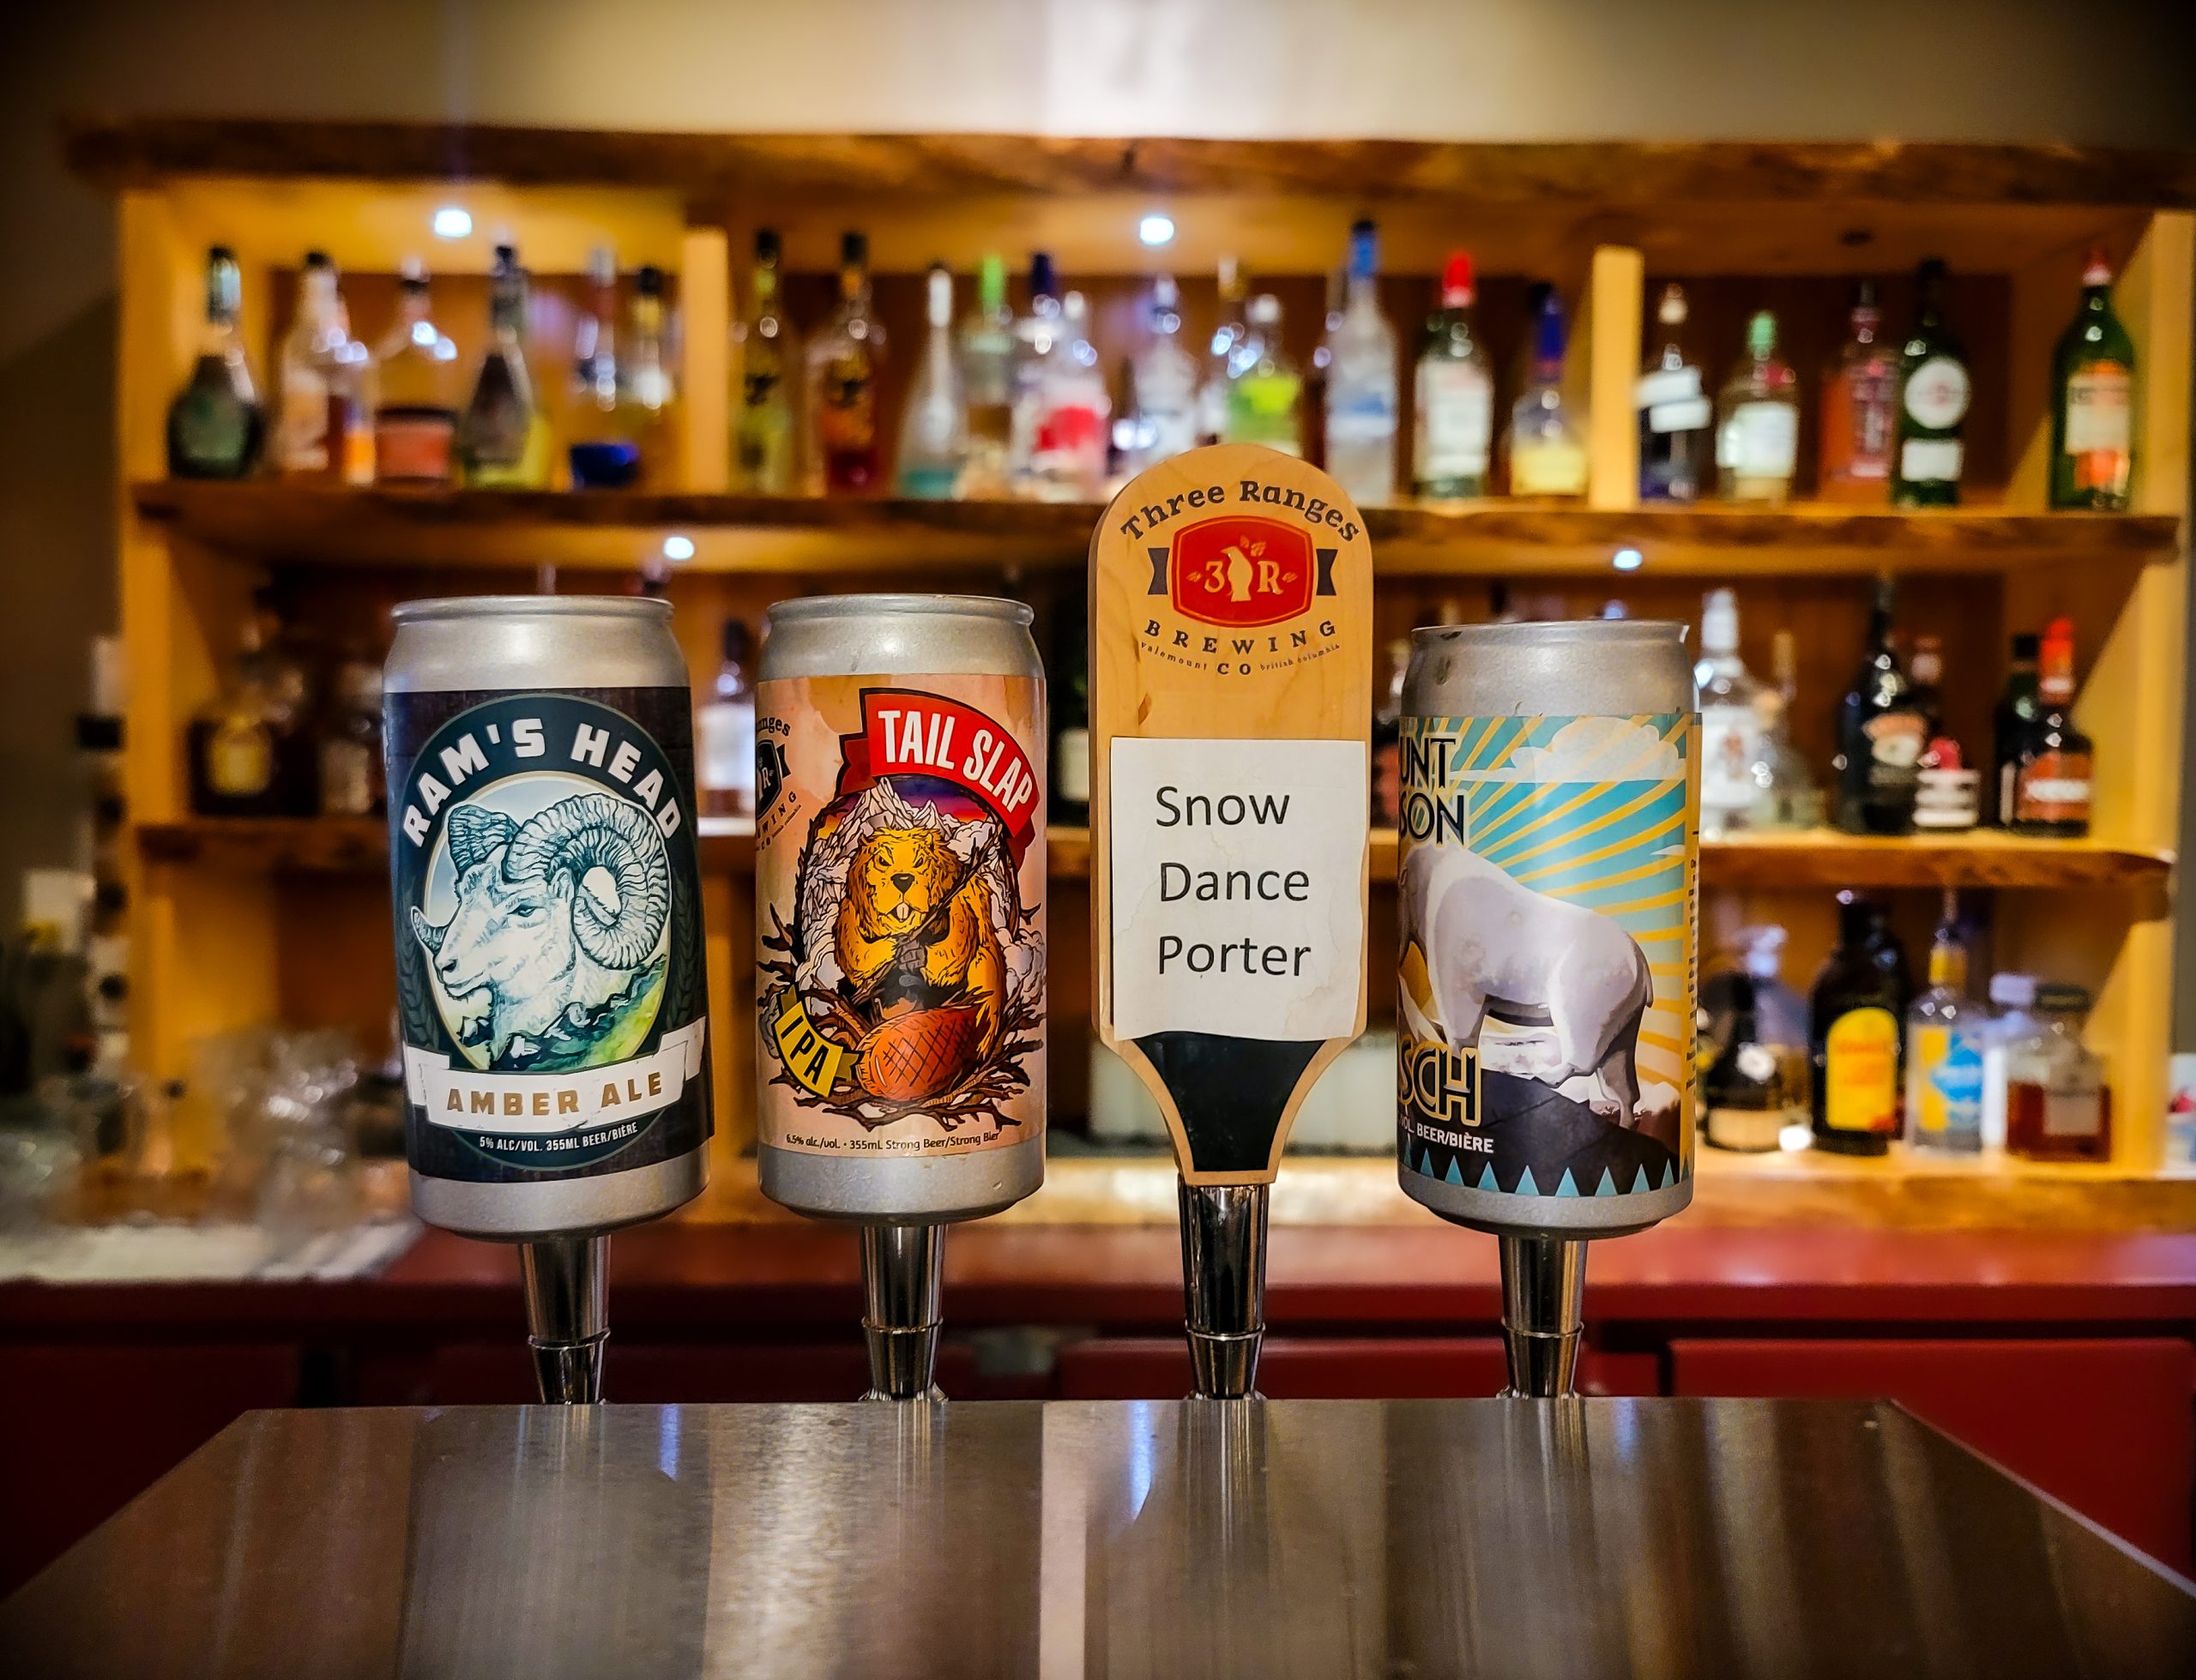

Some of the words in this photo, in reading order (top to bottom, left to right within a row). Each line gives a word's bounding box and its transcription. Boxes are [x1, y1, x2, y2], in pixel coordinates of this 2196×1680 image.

[1120, 485, 1225, 540] Three
[1240, 480, 1360, 542] Ranges
[1204, 560, 1225, 593] 3
[1257, 560, 1283, 594] R
[1144, 620, 1336, 655] BREWING
[1217, 662, 1252, 676] CO
[878, 710, 956, 770] TAIL
[962, 729, 1033, 813] SLAP
[403, 718, 546, 847] RAM'S
[570, 723, 682, 840] HEAD
[1155, 786, 1290, 827] Snow
[1161, 862, 1310, 901] Dance
[1159, 935, 1312, 976] Porter
[781, 1015, 830, 1086] IPA
[447, 1088, 580, 1116] AMBER
[600, 1072, 662, 1108] ALE
[480, 1136, 494, 1149] 5%
[497, 1138, 543, 1152] ALC/VOL.
[546, 1138, 580, 1152] 355ML
[582, 1122, 638, 1147] BEER/BIÈRE
[787, 1134, 805, 1146] 6.5%
[885, 1139, 920, 1151] Strong
[923, 1134, 980, 1149] Beer/Strong
[1416, 1123, 1494, 1153] BEER/BIÈRE
